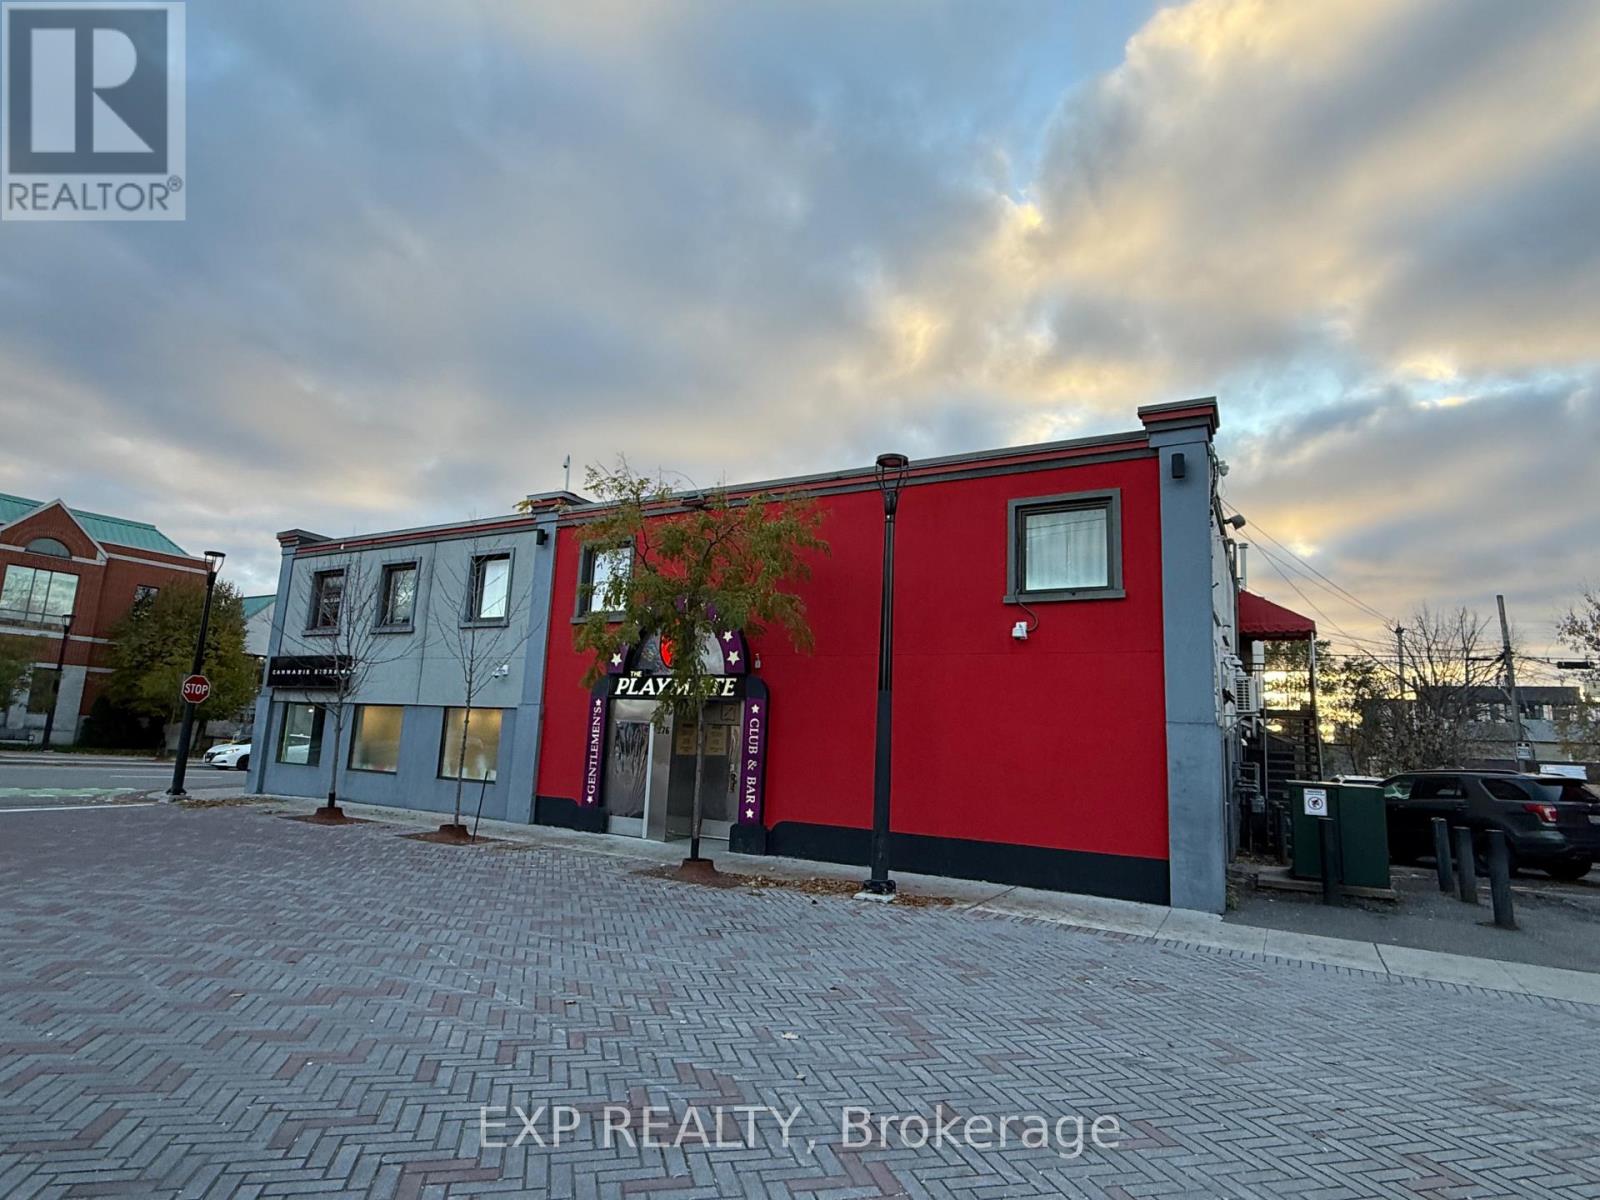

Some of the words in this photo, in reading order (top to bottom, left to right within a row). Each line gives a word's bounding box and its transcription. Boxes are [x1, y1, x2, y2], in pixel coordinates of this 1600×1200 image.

[630, 670, 642, 678] THE
[184, 683, 208, 695] STOP
[748, 718, 760, 754] CLUB
[587, 706, 602, 794] GENTLEMEN'S
[747, 759, 757, 771] &
[745, 776, 757, 804] BAR
